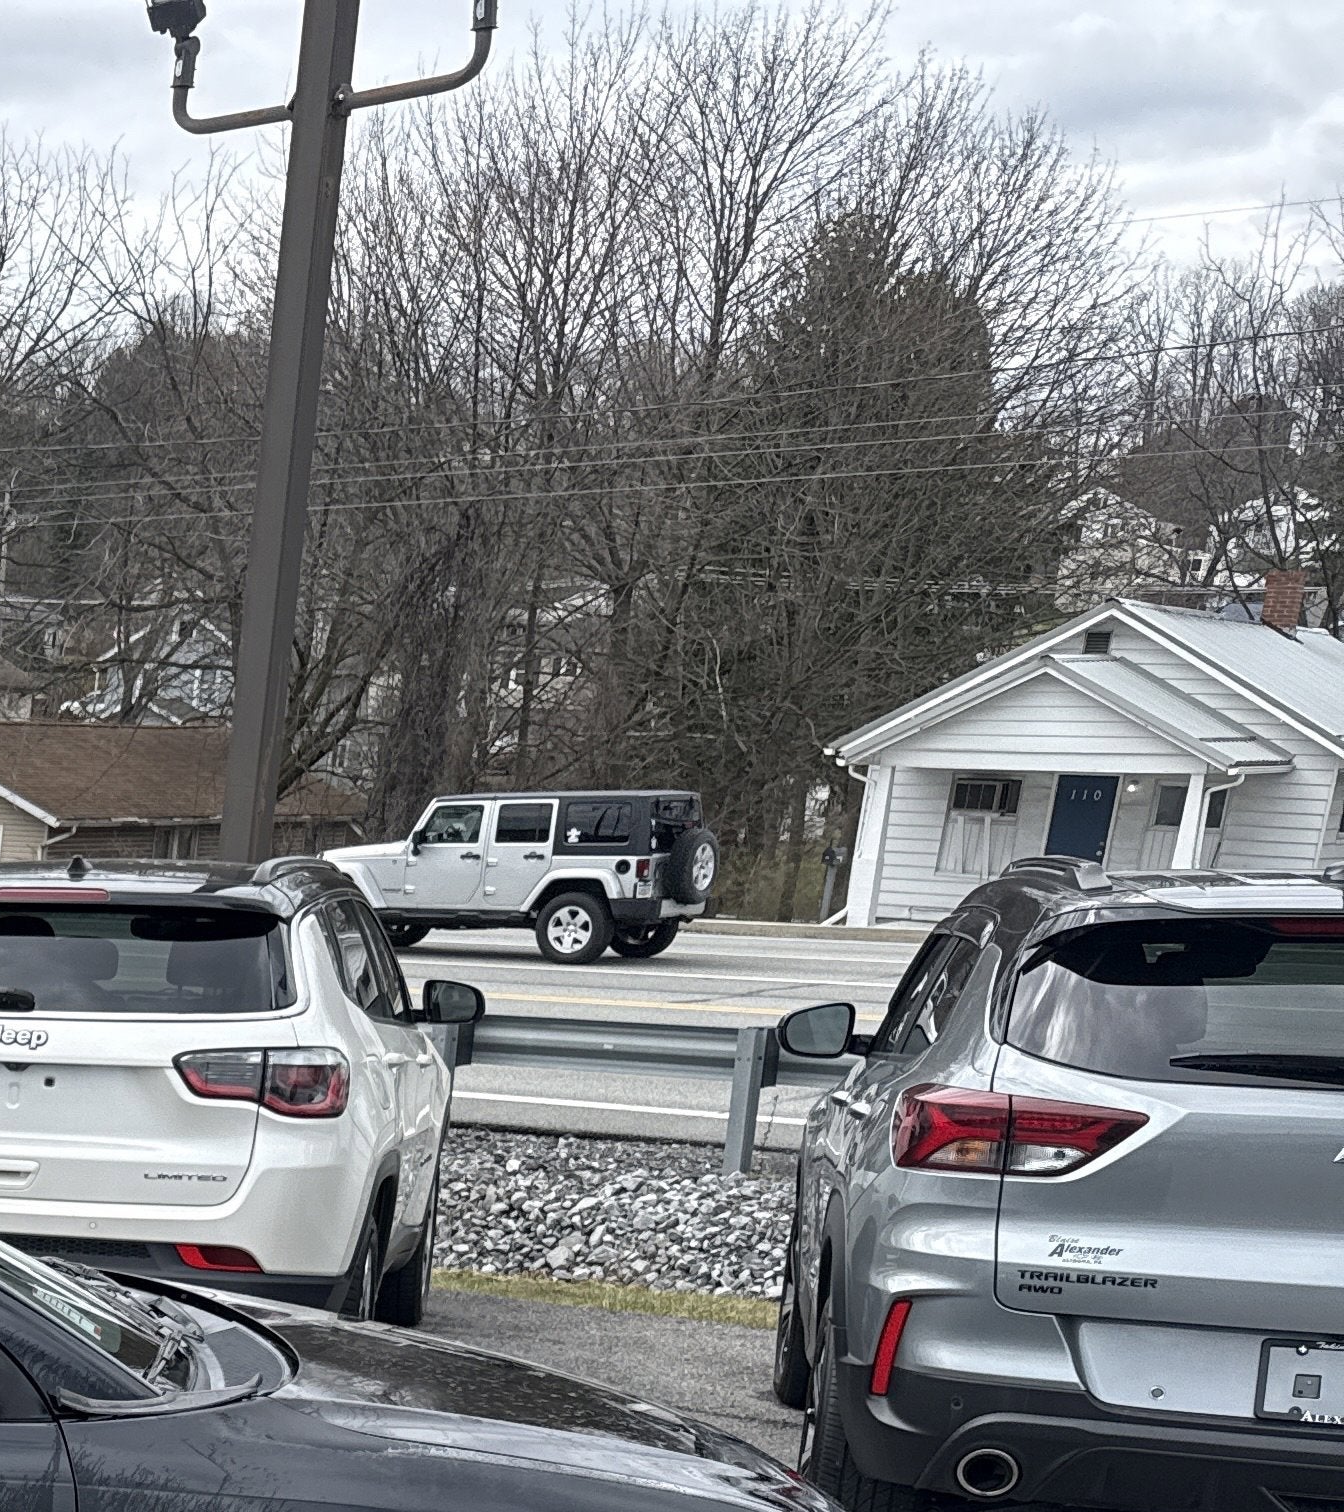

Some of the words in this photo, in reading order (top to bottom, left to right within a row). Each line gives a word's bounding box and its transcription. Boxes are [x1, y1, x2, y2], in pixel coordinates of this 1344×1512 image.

[1070, 789, 1102, 801] 110
[143, 1172, 228, 1182] LIMITED
[1048, 1234, 1080, 1244] Blaise
[1048, 1243, 1125, 1258] Alexander
[1017, 1269, 1159, 1289] TRAILBLAZER
[1018, 1284, 1063, 1295] AWD
